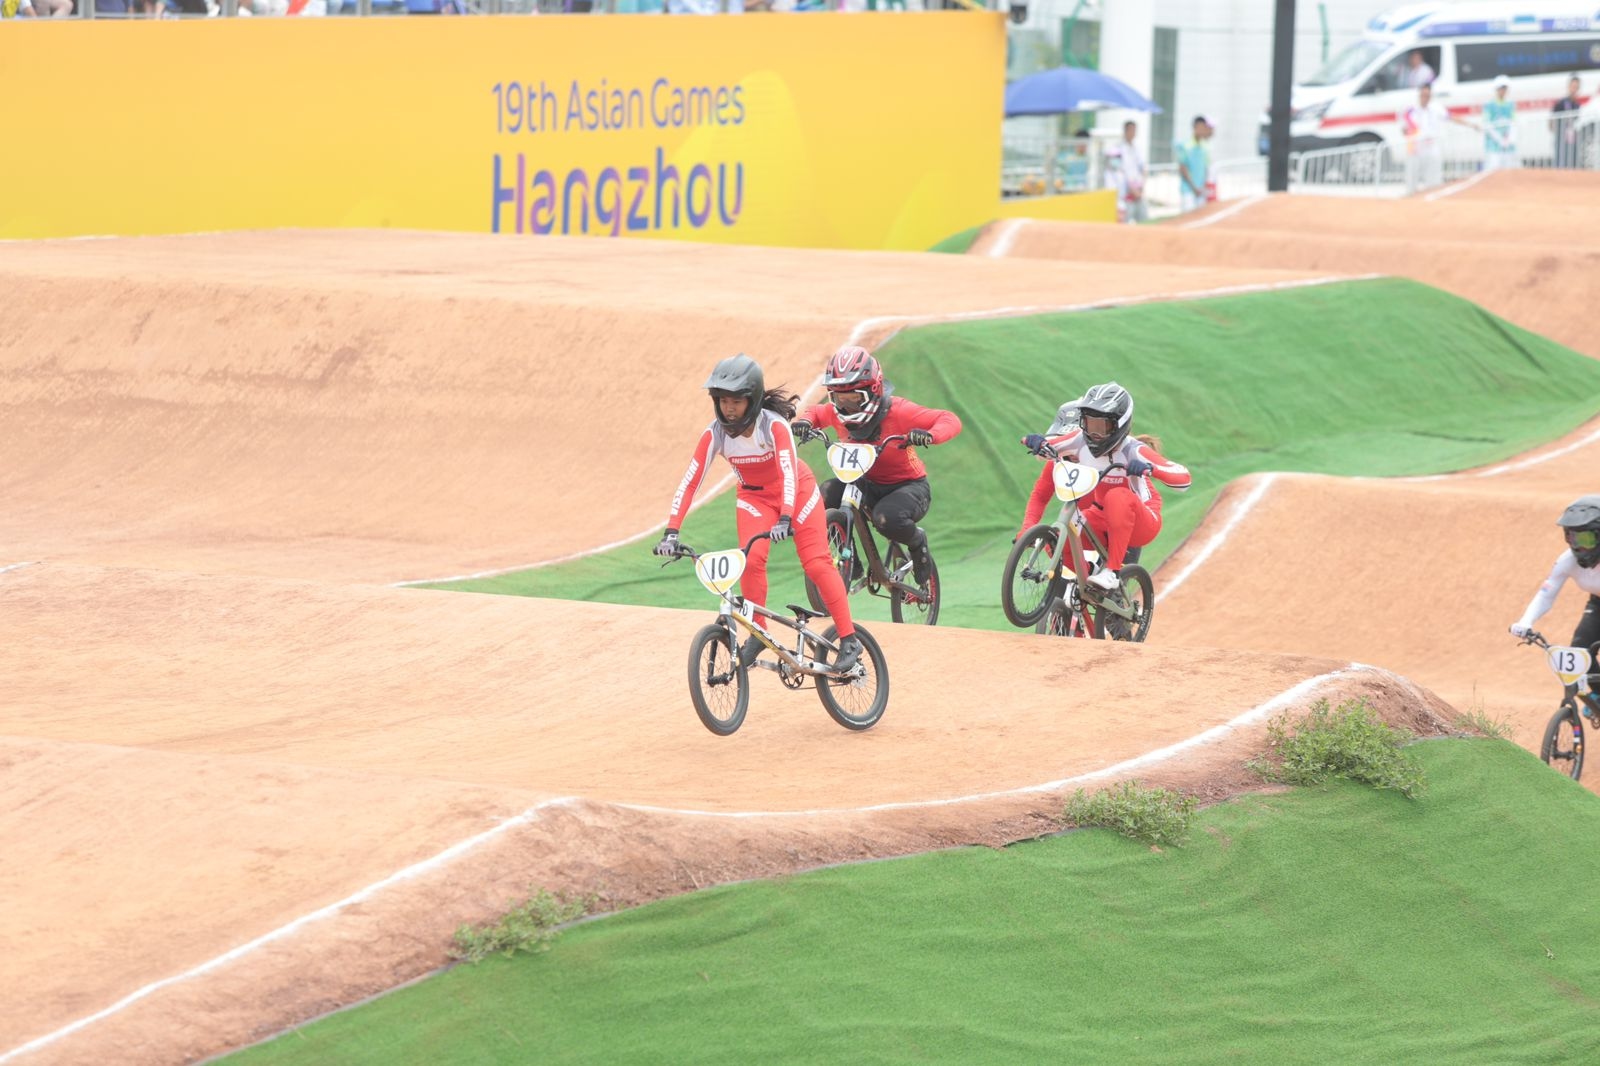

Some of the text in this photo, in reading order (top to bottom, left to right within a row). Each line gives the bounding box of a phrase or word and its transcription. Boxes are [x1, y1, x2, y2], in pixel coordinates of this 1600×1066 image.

[492, 77, 745, 133] 19th Asian Games
[491, 146, 744, 237] Hangzhou
[731, 452, 774, 464] INDONESIA
[840, 448, 859, 469] 14
[670, 457, 699, 516] INDONESIA
[779, 449, 795, 507] INDONESIA
[1065, 468, 1079, 487] 9
[711, 556, 729, 580] 10
[1559, 651, 1576, 672] 13
